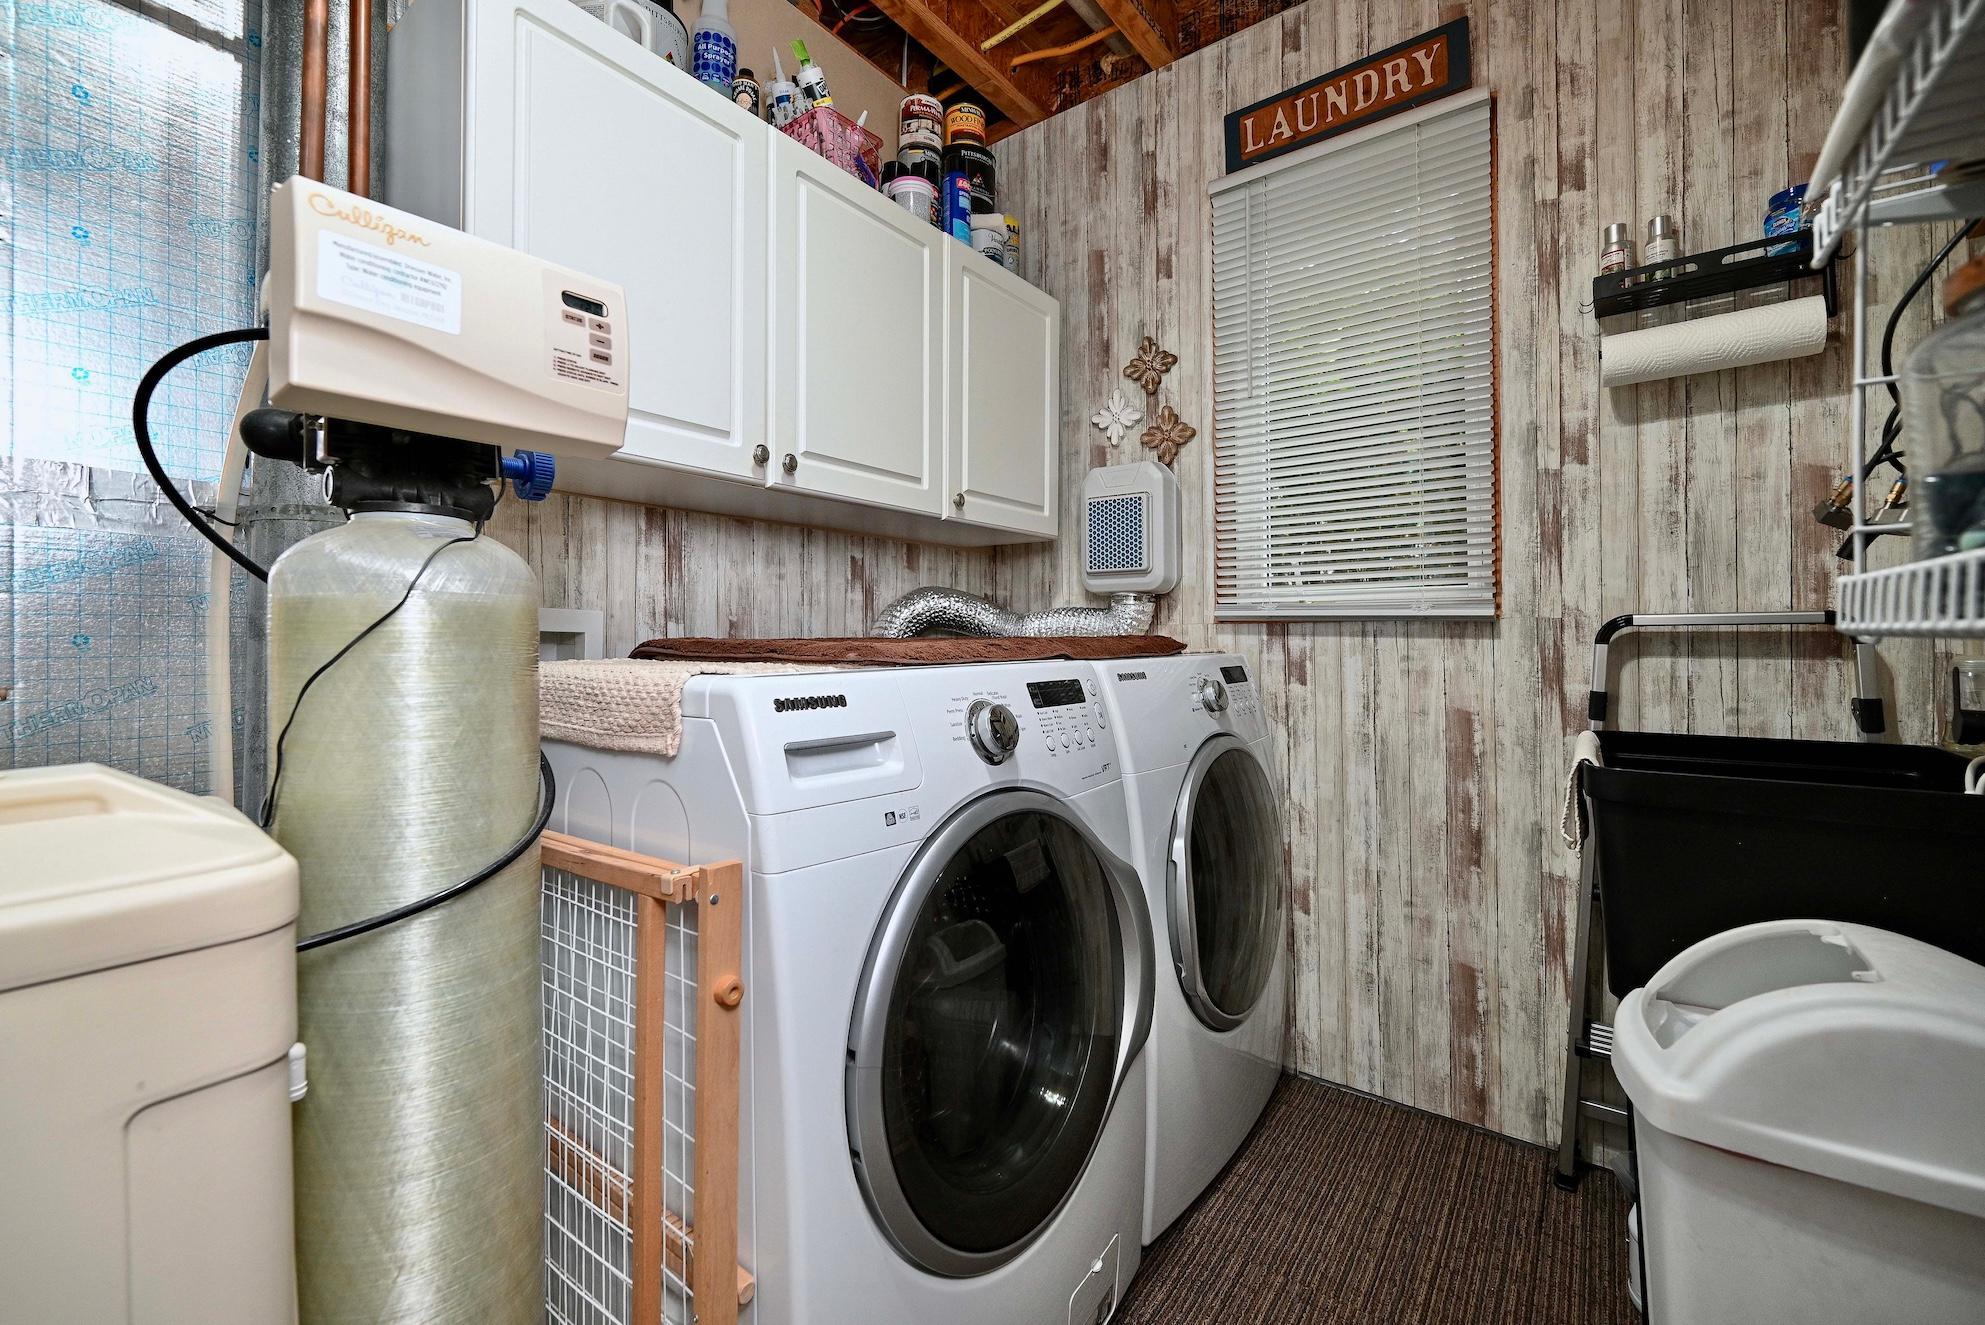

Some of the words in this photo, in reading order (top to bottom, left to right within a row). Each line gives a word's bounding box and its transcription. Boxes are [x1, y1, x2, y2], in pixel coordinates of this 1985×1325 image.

[697, 43, 707, 51] All
[703, 52, 730, 66] Sprayer
[1244, 43, 1440, 153] LAUNDRY
[950, 115, 973, 124] WOOD
[307, 191, 431, 247] Culligan
[1117, 671, 1147, 682] SAMSUNG
[773, 694, 848, 713] SAMSUNG
